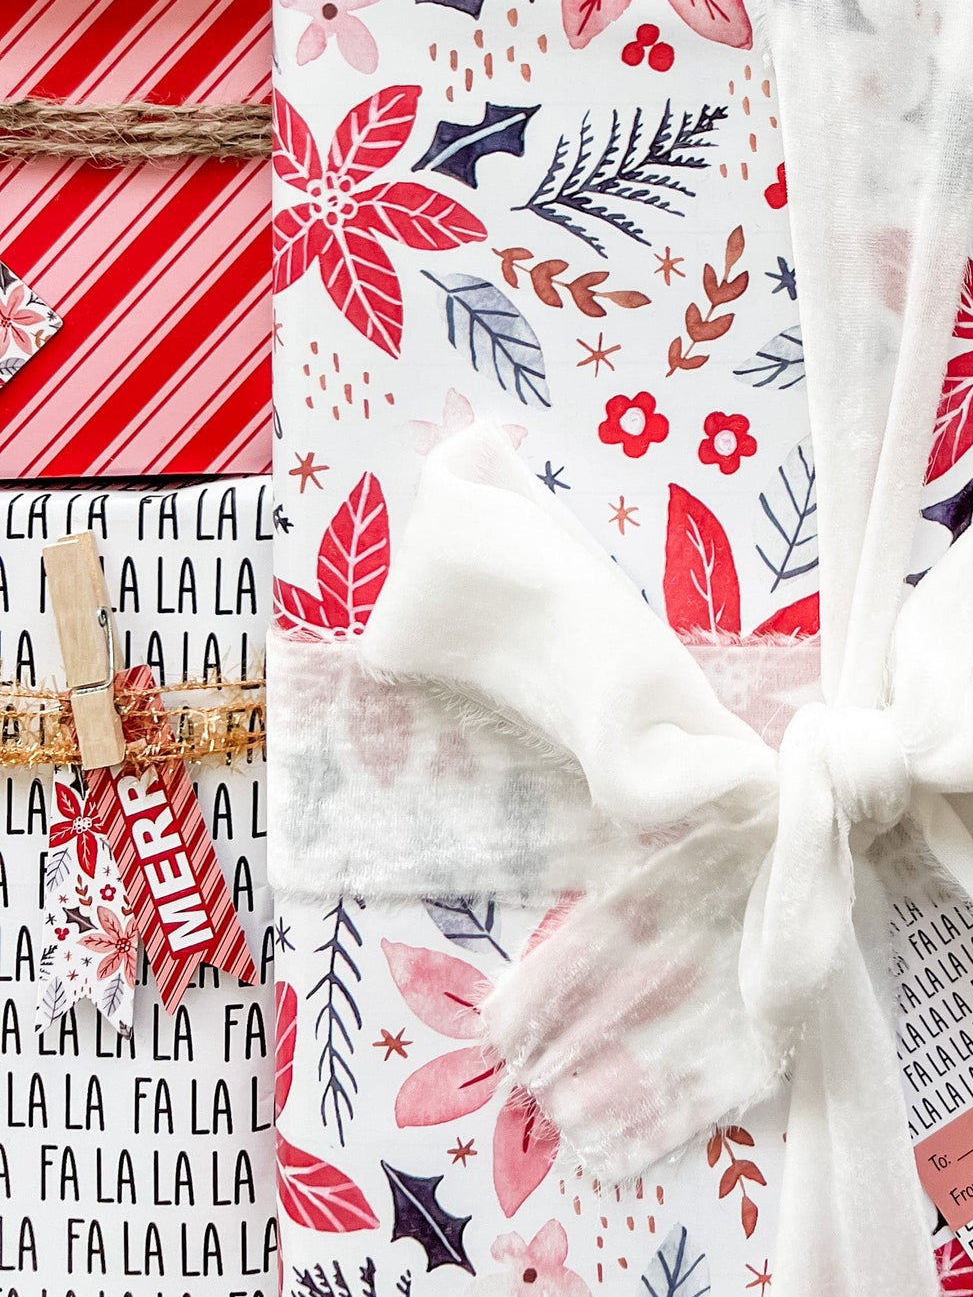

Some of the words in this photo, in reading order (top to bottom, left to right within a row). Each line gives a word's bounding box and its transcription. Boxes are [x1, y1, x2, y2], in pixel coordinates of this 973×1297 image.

[7, 494, 51, 539] LA
[139, 493, 178, 540] FA
[197, 487, 237, 540] LA
[158, 557, 197, 614] LA
[215, 558, 256, 615] LA
[7, 778, 47, 836] LA
[908, 929, 938, 961] FA
[930, 913, 962, 946] LA
[914, 967, 945, 999] LA
[937, 951, 969, 984] LA
[153, 1004, 193, 1061] LA
[225, 1003, 266, 1062] FA
[901, 1022, 927, 1054] LA
[918, 1006, 950, 1039] LA
[941, 991, 973, 1023] LA
[902, 1060, 933, 1093] FA
[925, 1045, 957, 1077] LA
[8, 1072, 47, 1128] LA
[66, 1074, 104, 1131] LA
[135, 1078, 173, 1134] FA
[192, 1079, 233, 1135] LA
[911, 1097, 943, 1130] LA
[935, 1081, 966, 1114] LA
[41, 1145, 79, 1201] FA
[97, 1148, 136, 1204] LA
[154, 1151, 194, 1206] LA
[213, 1150, 255, 1205] LA
[928, 1154, 952, 1173] To:
[68, 1219, 106, 1274] FA
[124, 1221, 164, 1276] LA
[182, 1223, 223, 1276] LA
